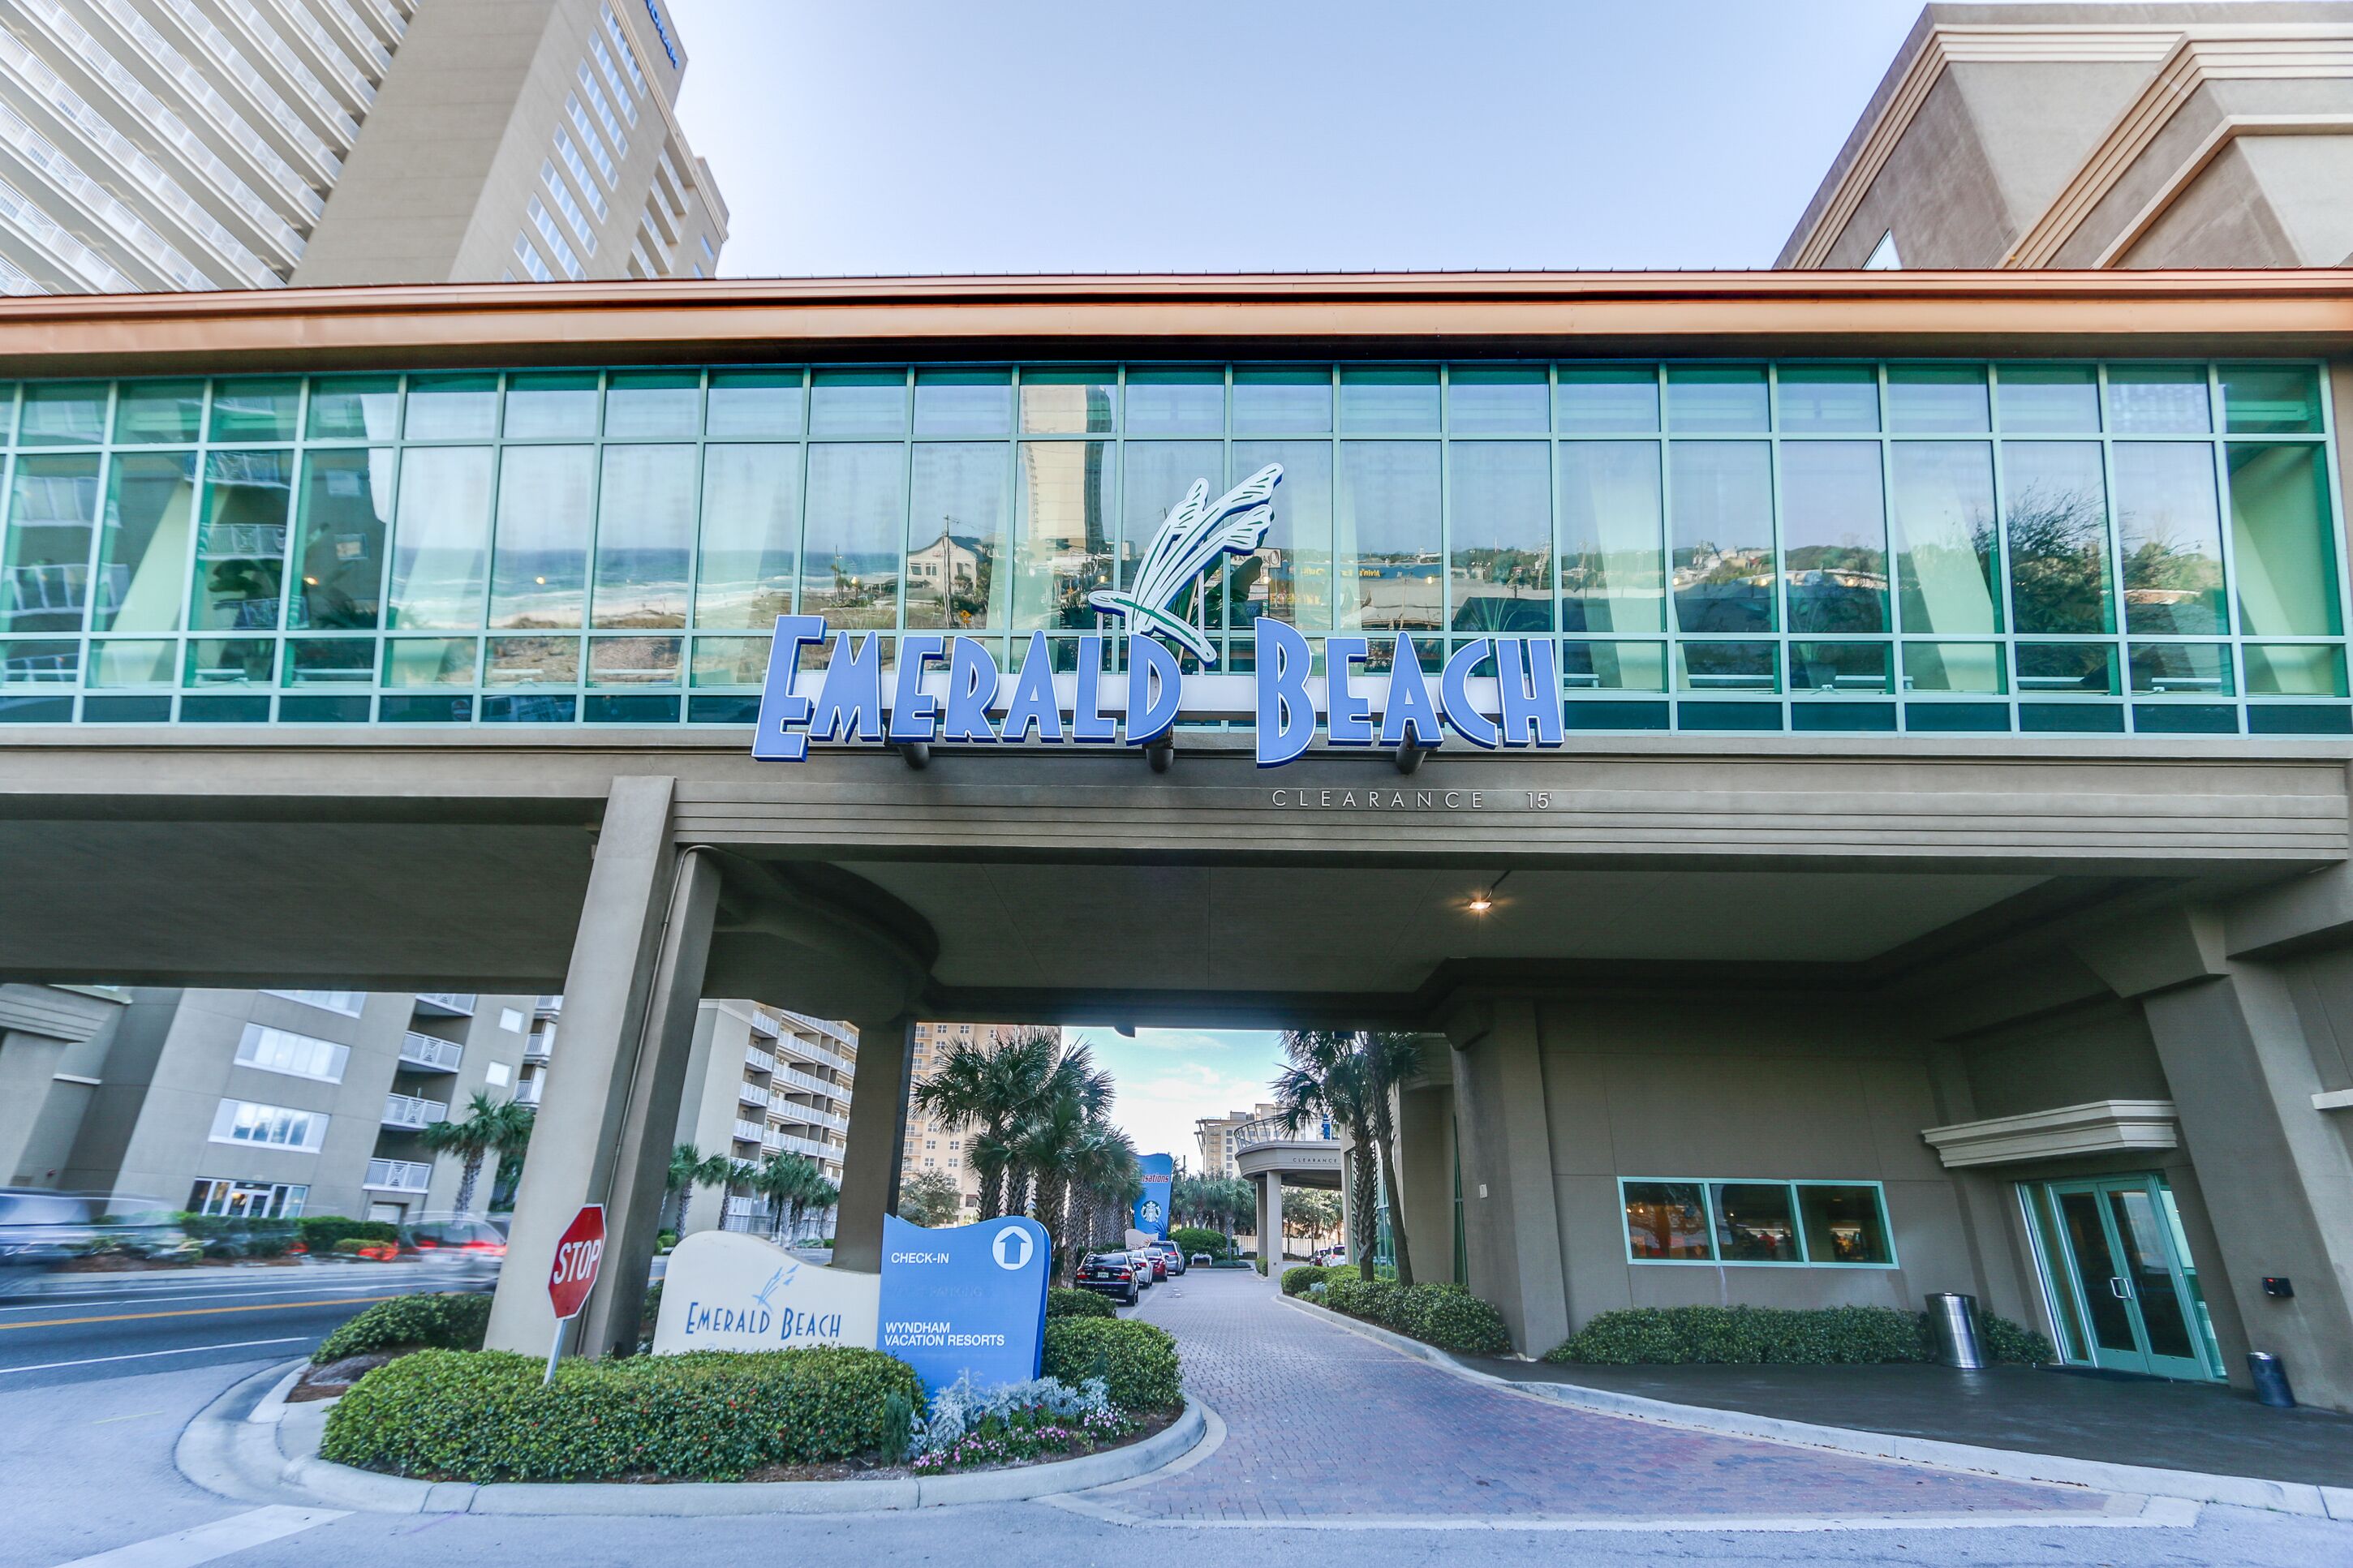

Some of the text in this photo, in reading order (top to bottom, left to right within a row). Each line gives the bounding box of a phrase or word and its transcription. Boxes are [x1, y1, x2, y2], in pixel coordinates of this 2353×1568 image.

[751, 614, 1566, 769] EMERALD BEACH
[1271, 789, 1553, 810] CLEARANCE 15'
[1142, 1173, 1169, 1183] nsations
[553, 1239, 603, 1285] STOP
[891, 1252, 950, 1264] CHECK-IN
[686, 1302, 841, 1340] EMERALD BEACH
[885, 1321, 951, 1334] WYNDHAM
[884, 1334, 1005, 1347] VACATION RESORTS
